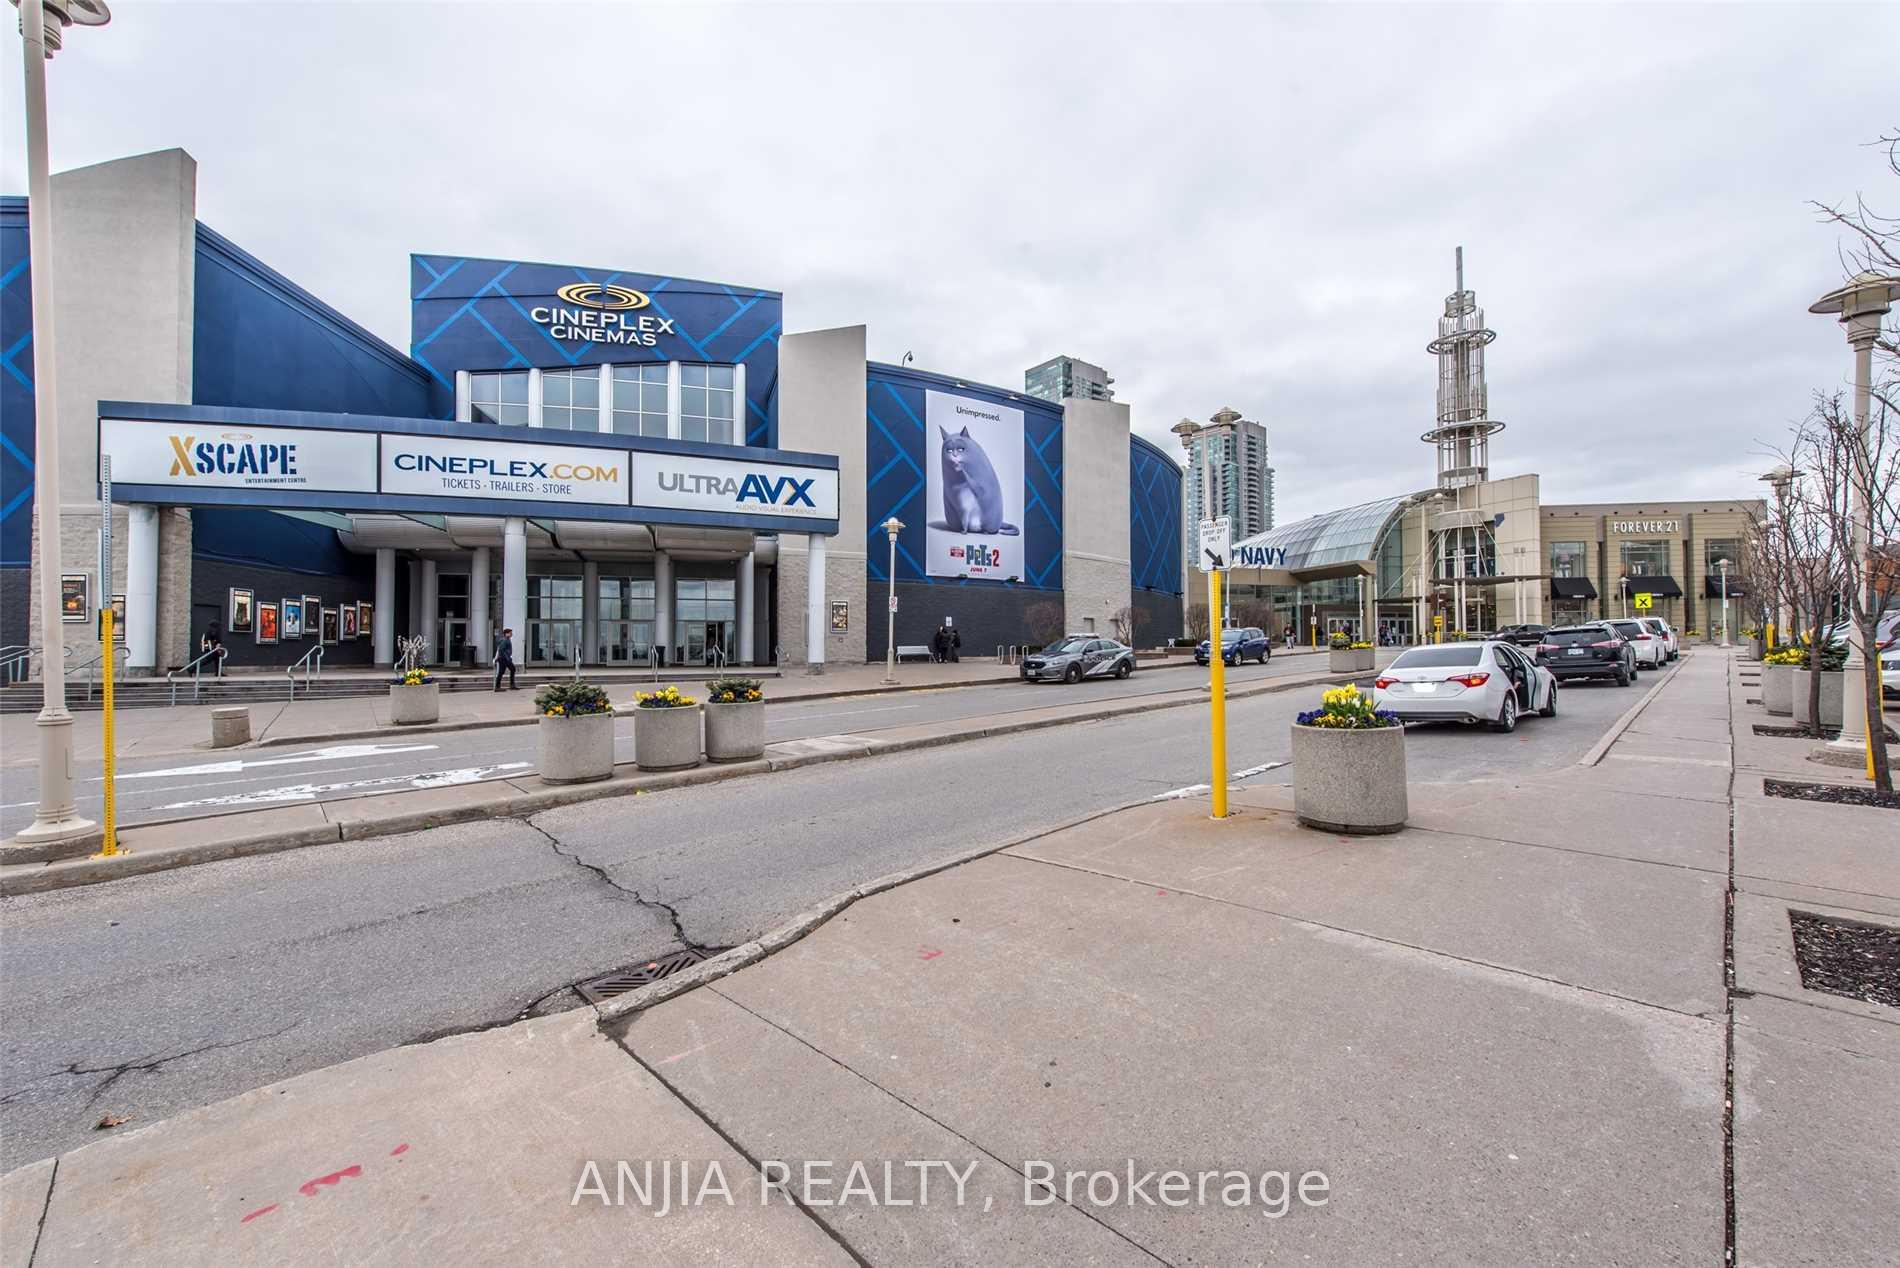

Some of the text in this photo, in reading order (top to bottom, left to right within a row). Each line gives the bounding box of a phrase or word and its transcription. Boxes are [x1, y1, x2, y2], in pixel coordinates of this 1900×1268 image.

[530, 307, 675, 334] CINEPLEX
[550, 325, 657, 346] CINEMAS
[956, 405, 1001, 422] Unimpressed.
[168, 435, 298, 477] XSCAPE
[393, 453, 618, 483] CINEPLEX.COM
[441, 477, 481, 490] TICKETS
[490, 480, 534, 493] TRAILERS
[542, 483, 572, 495] STORE
[1613, 520, 1679, 533] FOREVER 21
[992, 549, 999, 567] 2
[1240, 547, 1287, 566] NAVY
